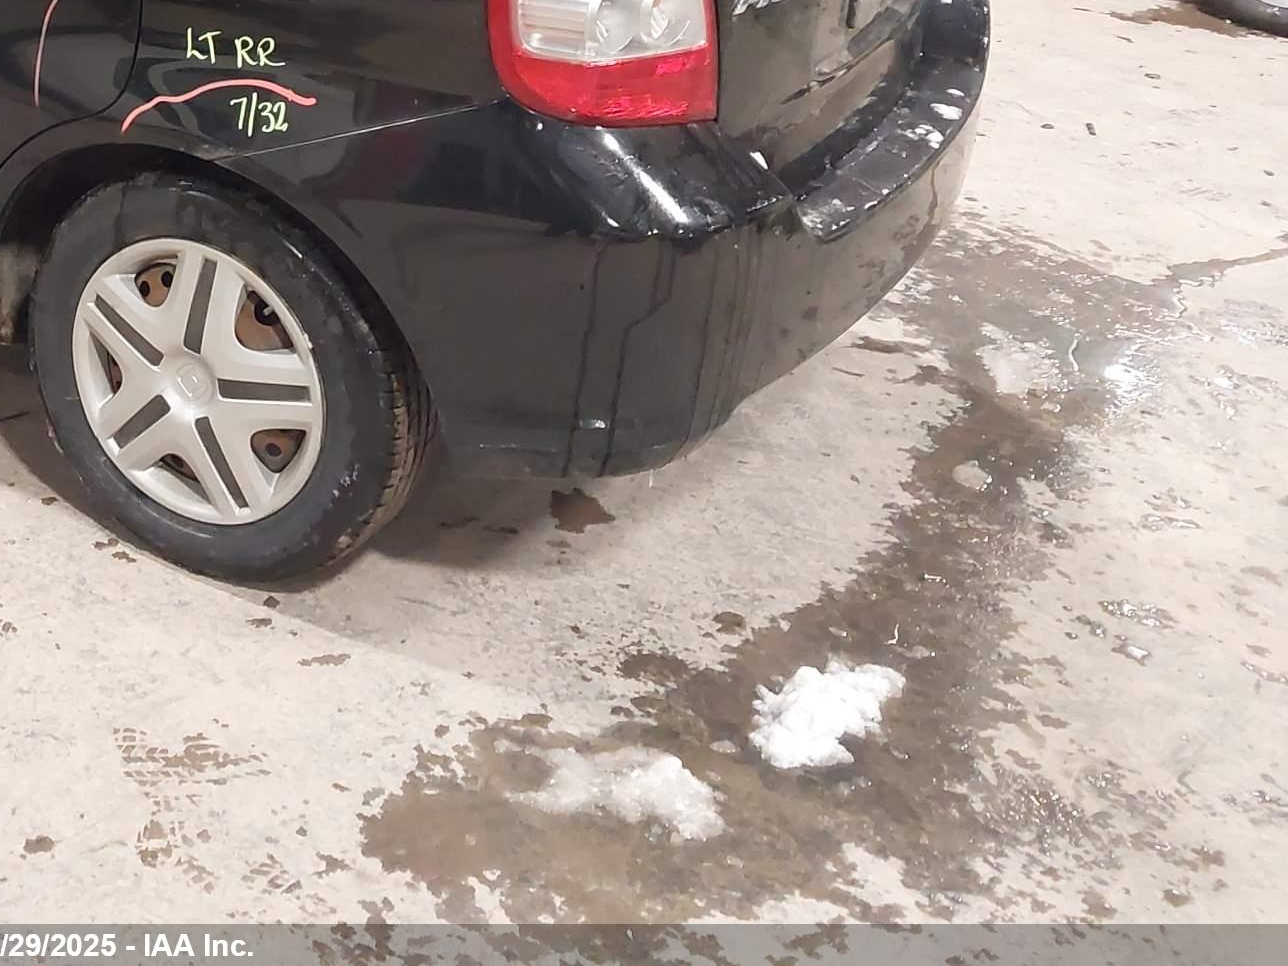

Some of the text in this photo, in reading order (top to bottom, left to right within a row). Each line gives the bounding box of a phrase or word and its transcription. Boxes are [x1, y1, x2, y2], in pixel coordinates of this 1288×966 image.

[185, 26, 287, 69] LT RR
[229, 91, 289, 138] 7/32
